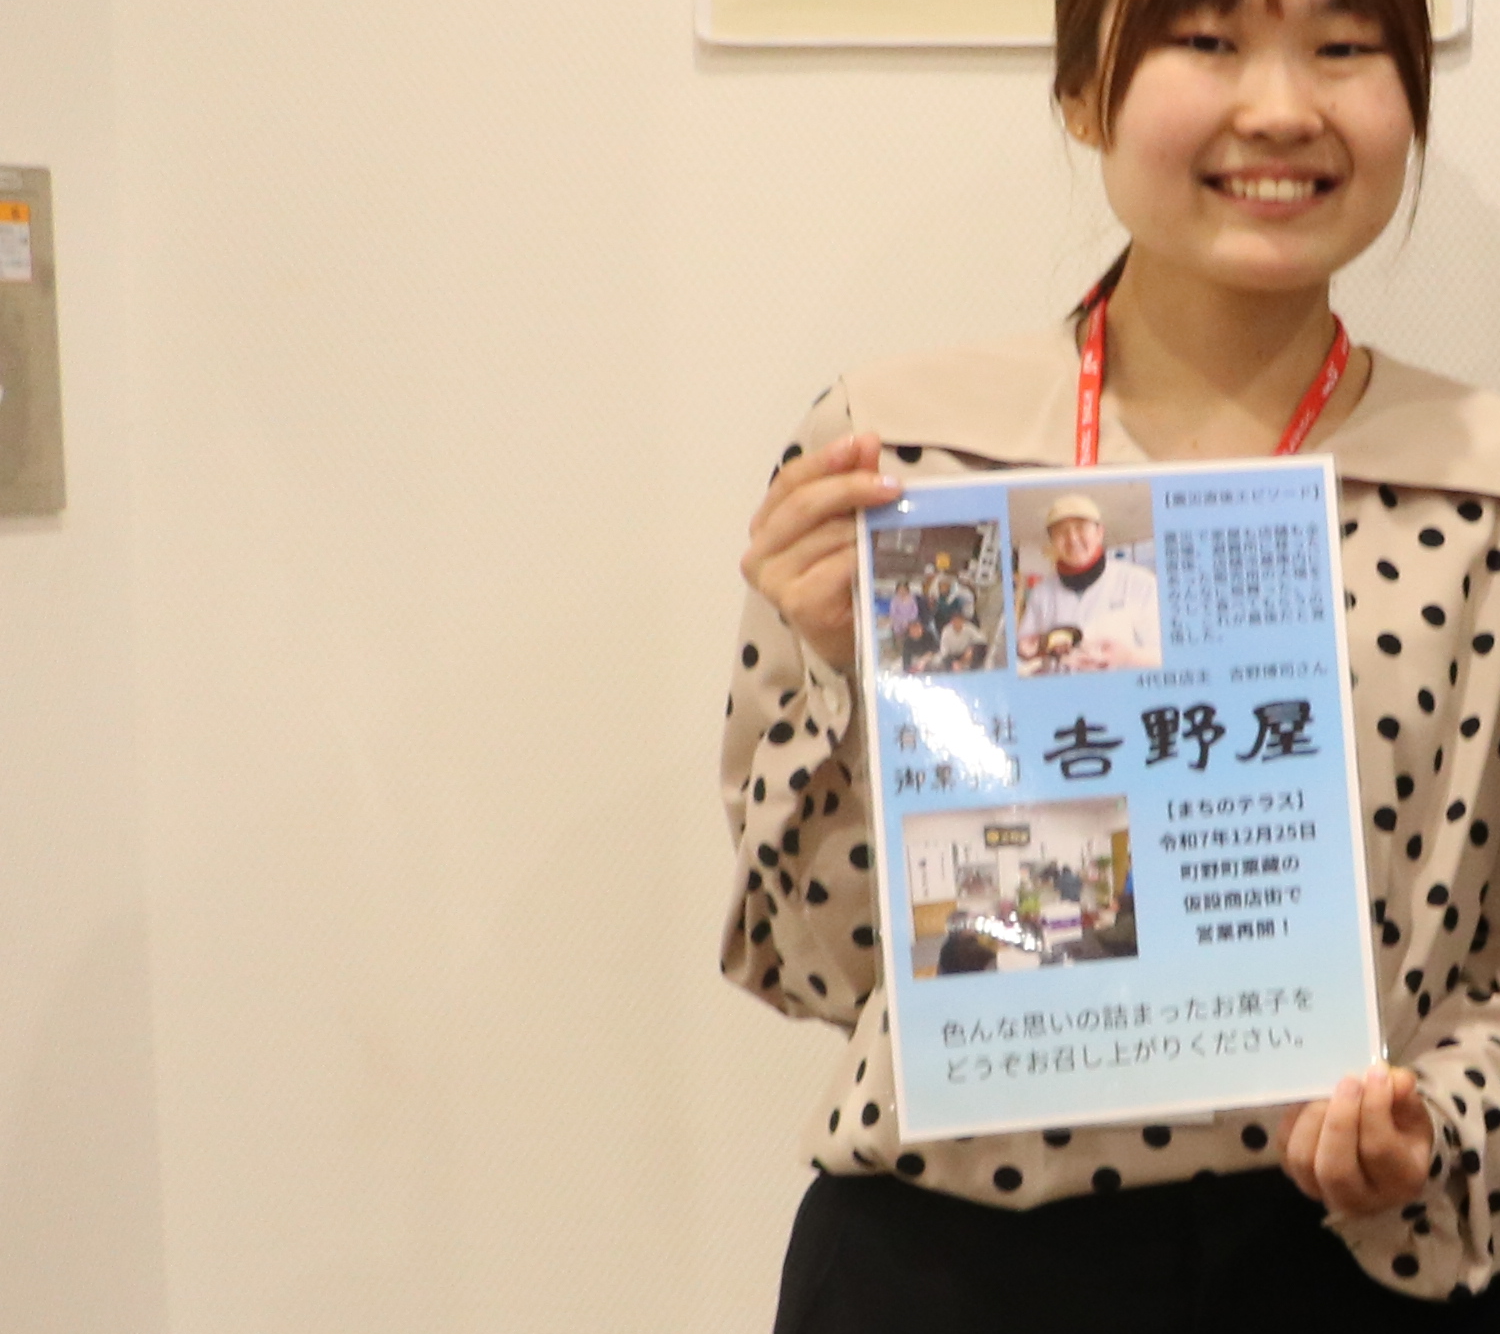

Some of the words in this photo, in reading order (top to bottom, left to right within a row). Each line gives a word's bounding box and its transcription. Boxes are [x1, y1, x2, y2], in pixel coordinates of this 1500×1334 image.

[942, 986, 1315, 1050] 色んな思いの詰まったお菓子を
[944, 1024, 1307, 1085] どうぞお召し上がりください。
